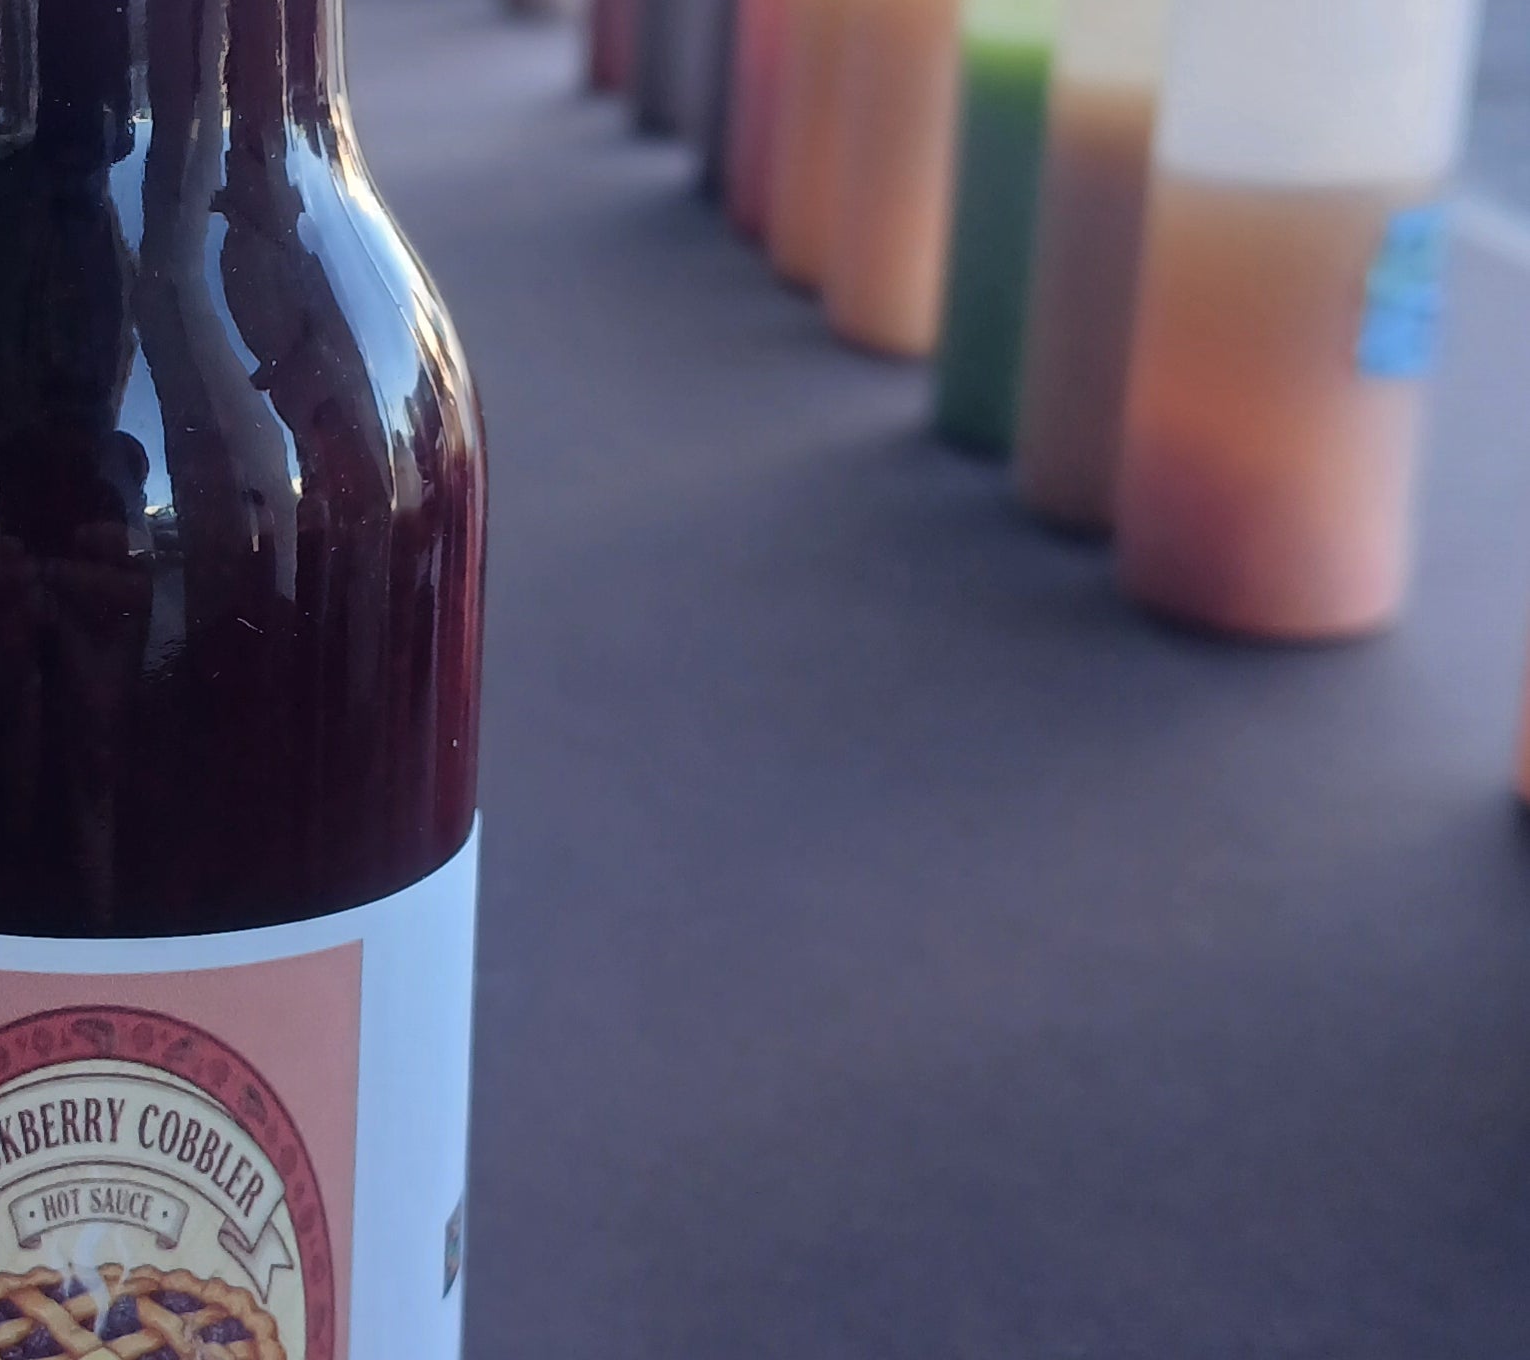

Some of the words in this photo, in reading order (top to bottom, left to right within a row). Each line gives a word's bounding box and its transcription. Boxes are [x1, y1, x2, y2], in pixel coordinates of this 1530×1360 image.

[138, 1103, 265, 1218] COBBLER
[41, 1187, 80, 1222] HOT
[90, 1187, 155, 1222] SAUCE
